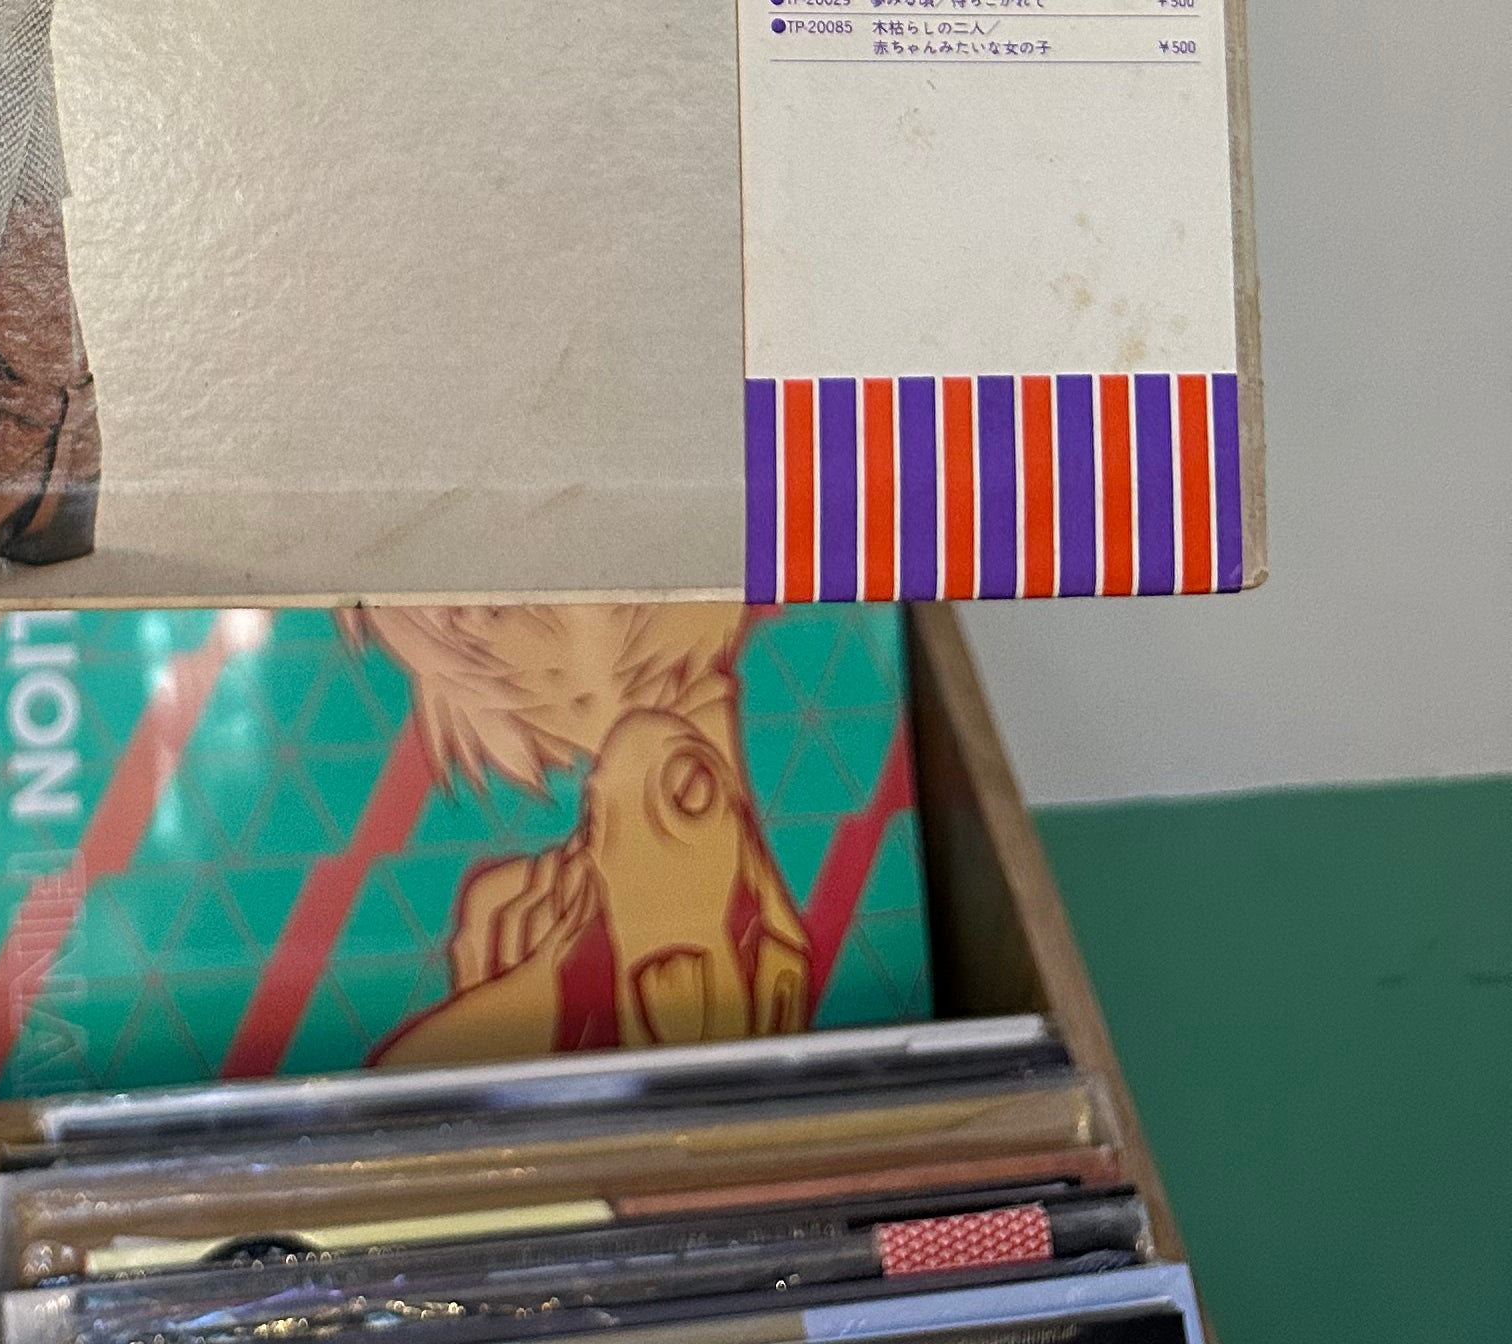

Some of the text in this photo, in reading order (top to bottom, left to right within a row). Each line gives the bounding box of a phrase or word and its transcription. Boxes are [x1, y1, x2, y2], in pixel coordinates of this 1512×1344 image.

[787, 20, 853, 34] TP-20085
[872, 39, 1197, 56] 赤ちゃんみたいな女の子 ¥500
